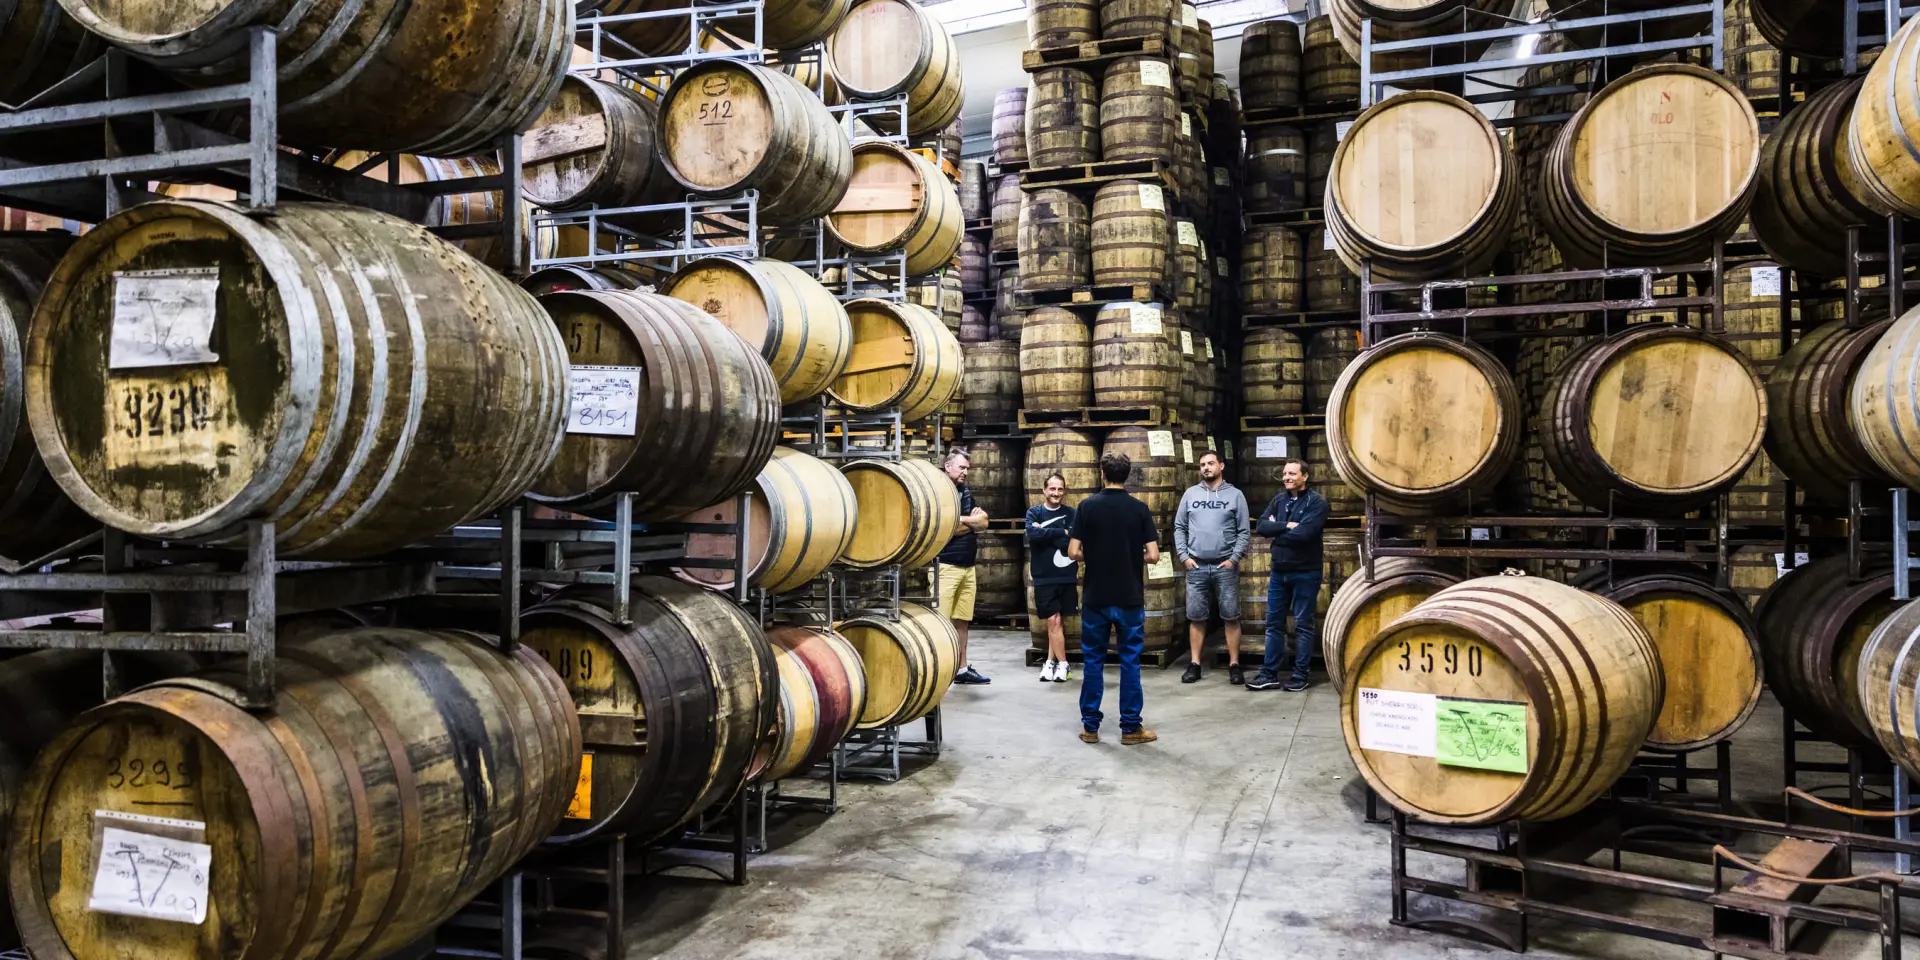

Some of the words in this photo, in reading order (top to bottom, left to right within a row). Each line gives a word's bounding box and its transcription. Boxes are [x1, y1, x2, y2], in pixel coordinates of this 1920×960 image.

[698, 100, 733, 120] 512
[569, 322, 602, 354] 51
[579, 407, 628, 428] 8151
[1192, 500, 1229, 509] OAKLEY
[1398, 641, 1483, 677] 3590
